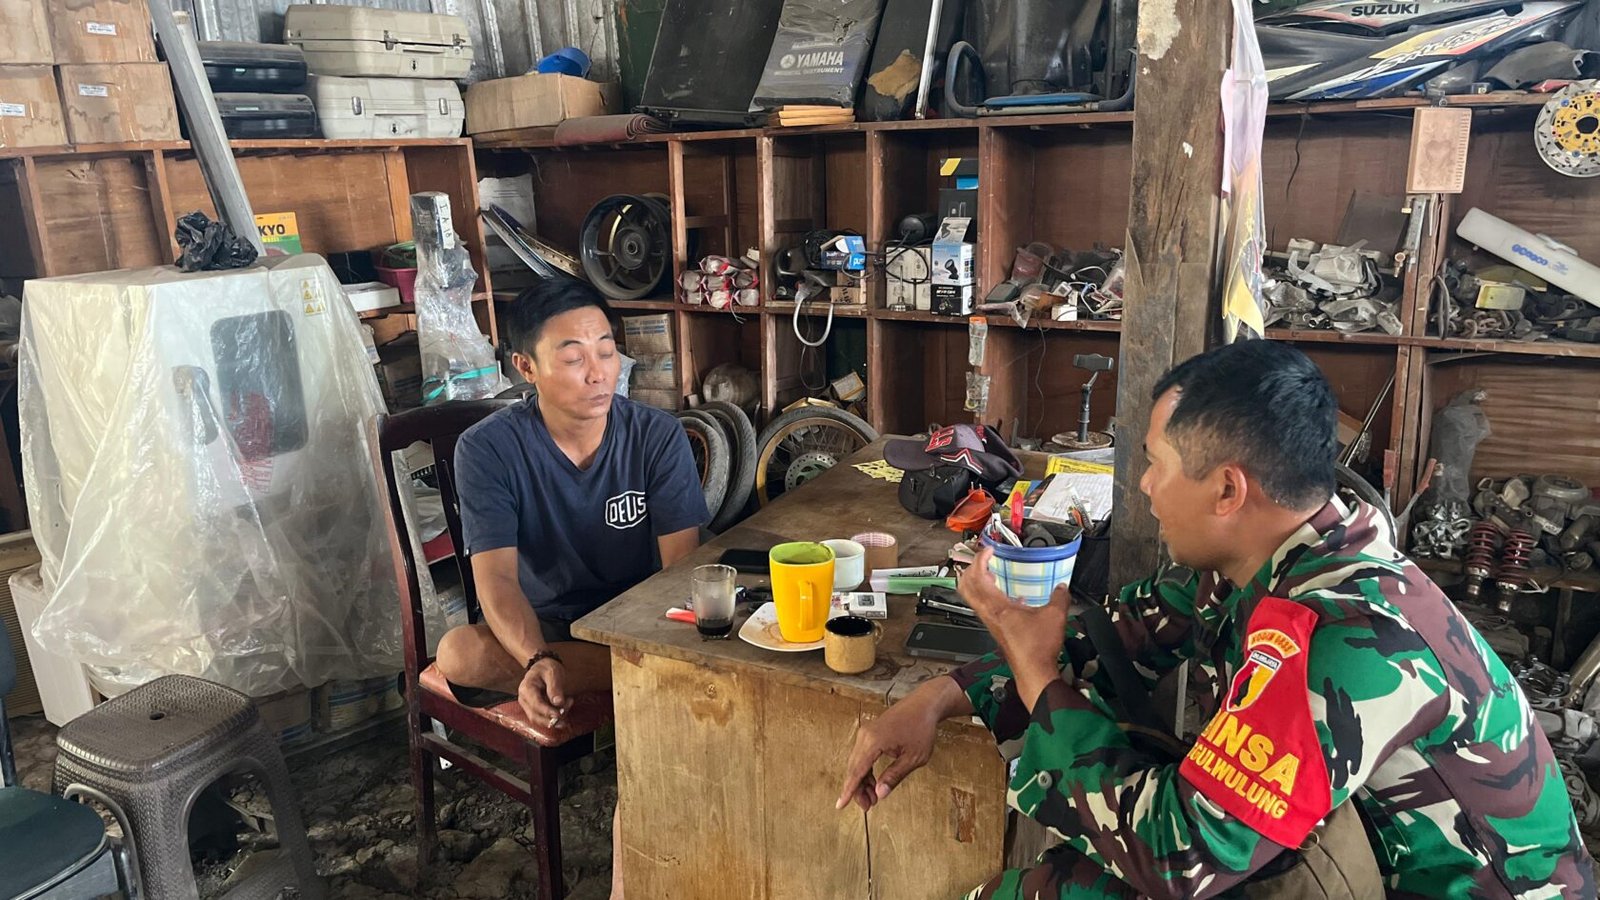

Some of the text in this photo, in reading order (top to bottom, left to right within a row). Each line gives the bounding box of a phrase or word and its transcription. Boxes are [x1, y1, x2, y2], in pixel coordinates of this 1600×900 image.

[1351, 3, 1419, 17] SUZUKI
[797, 51, 844, 68] YAMAHA
[609, 495, 646, 522] DEUS
[1200, 707, 1300, 796] INSA
[1186, 741, 1288, 819] GULWULUNG
